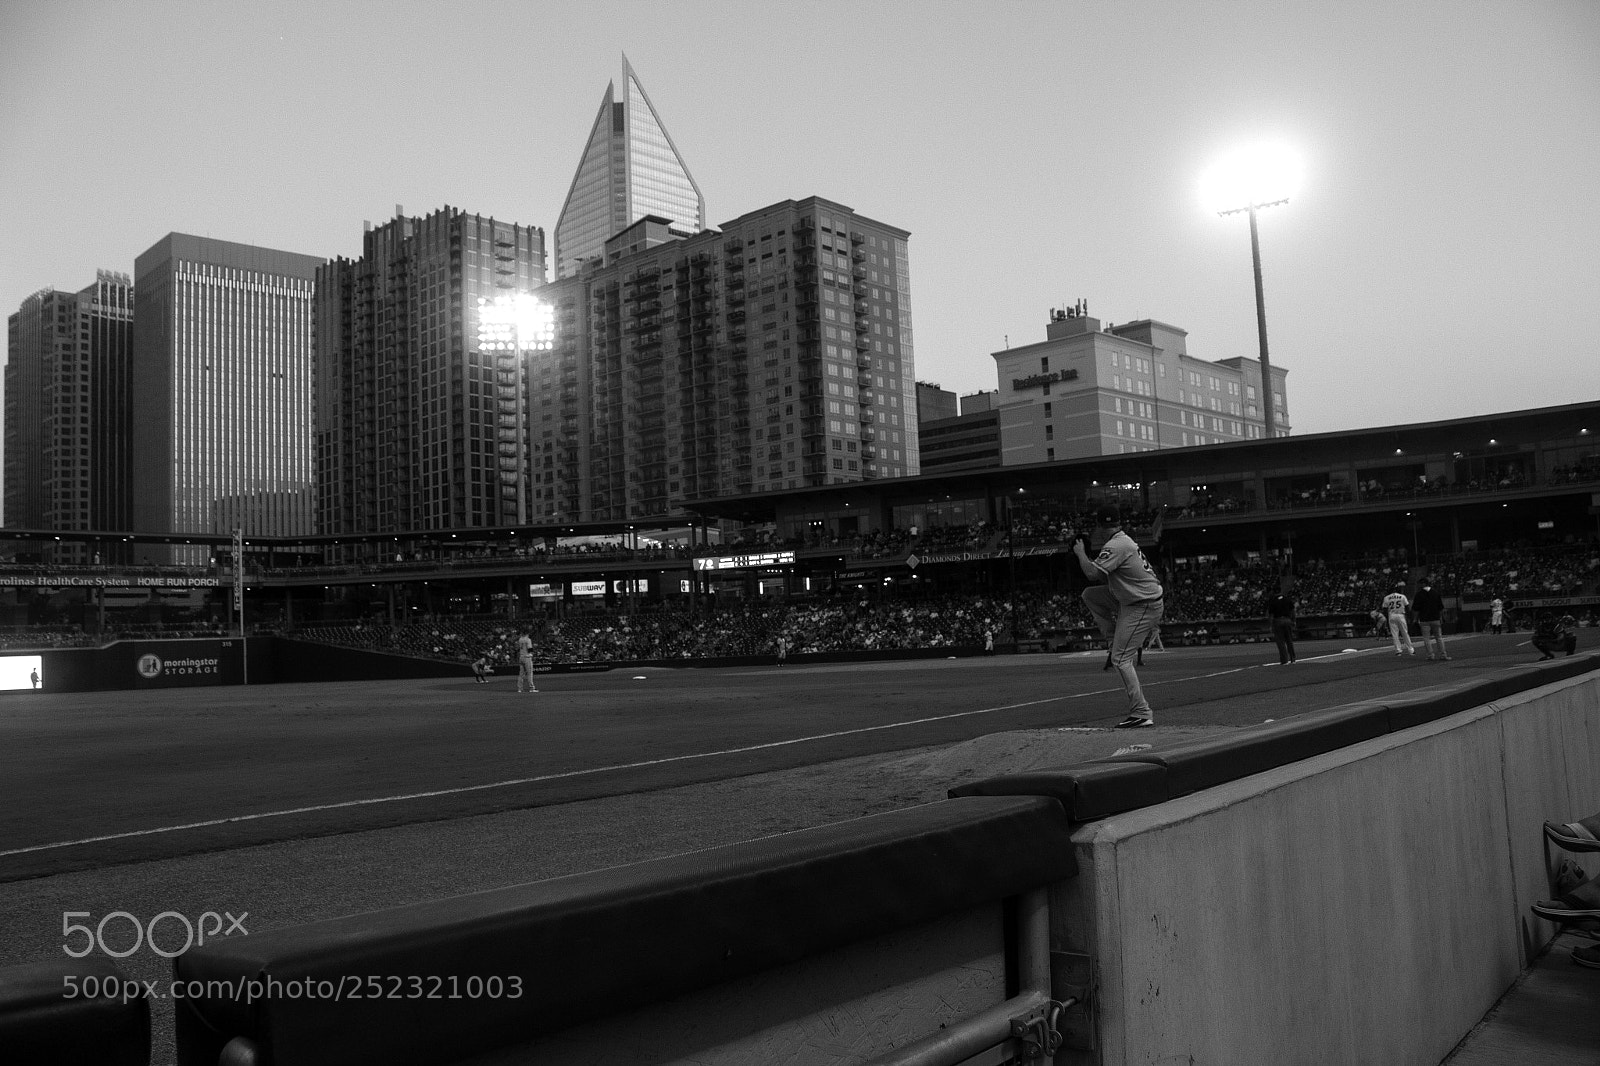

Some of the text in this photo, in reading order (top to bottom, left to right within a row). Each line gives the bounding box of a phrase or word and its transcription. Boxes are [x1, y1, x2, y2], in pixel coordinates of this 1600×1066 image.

[922, 555, 961, 564] DIAMONDS
[963, 552, 991, 562] DIRECT
[38, 576, 94, 586] HealthCare
[96, 577, 130, 588] System
[137, 578, 219, 587] HOME RUN PORCH
[572, 584, 605, 592] SUBWAY
[1389, 601, 1402, 610] 25
[163, 658, 218, 668] morningstar
[164, 666, 218, 675] STORAGE
